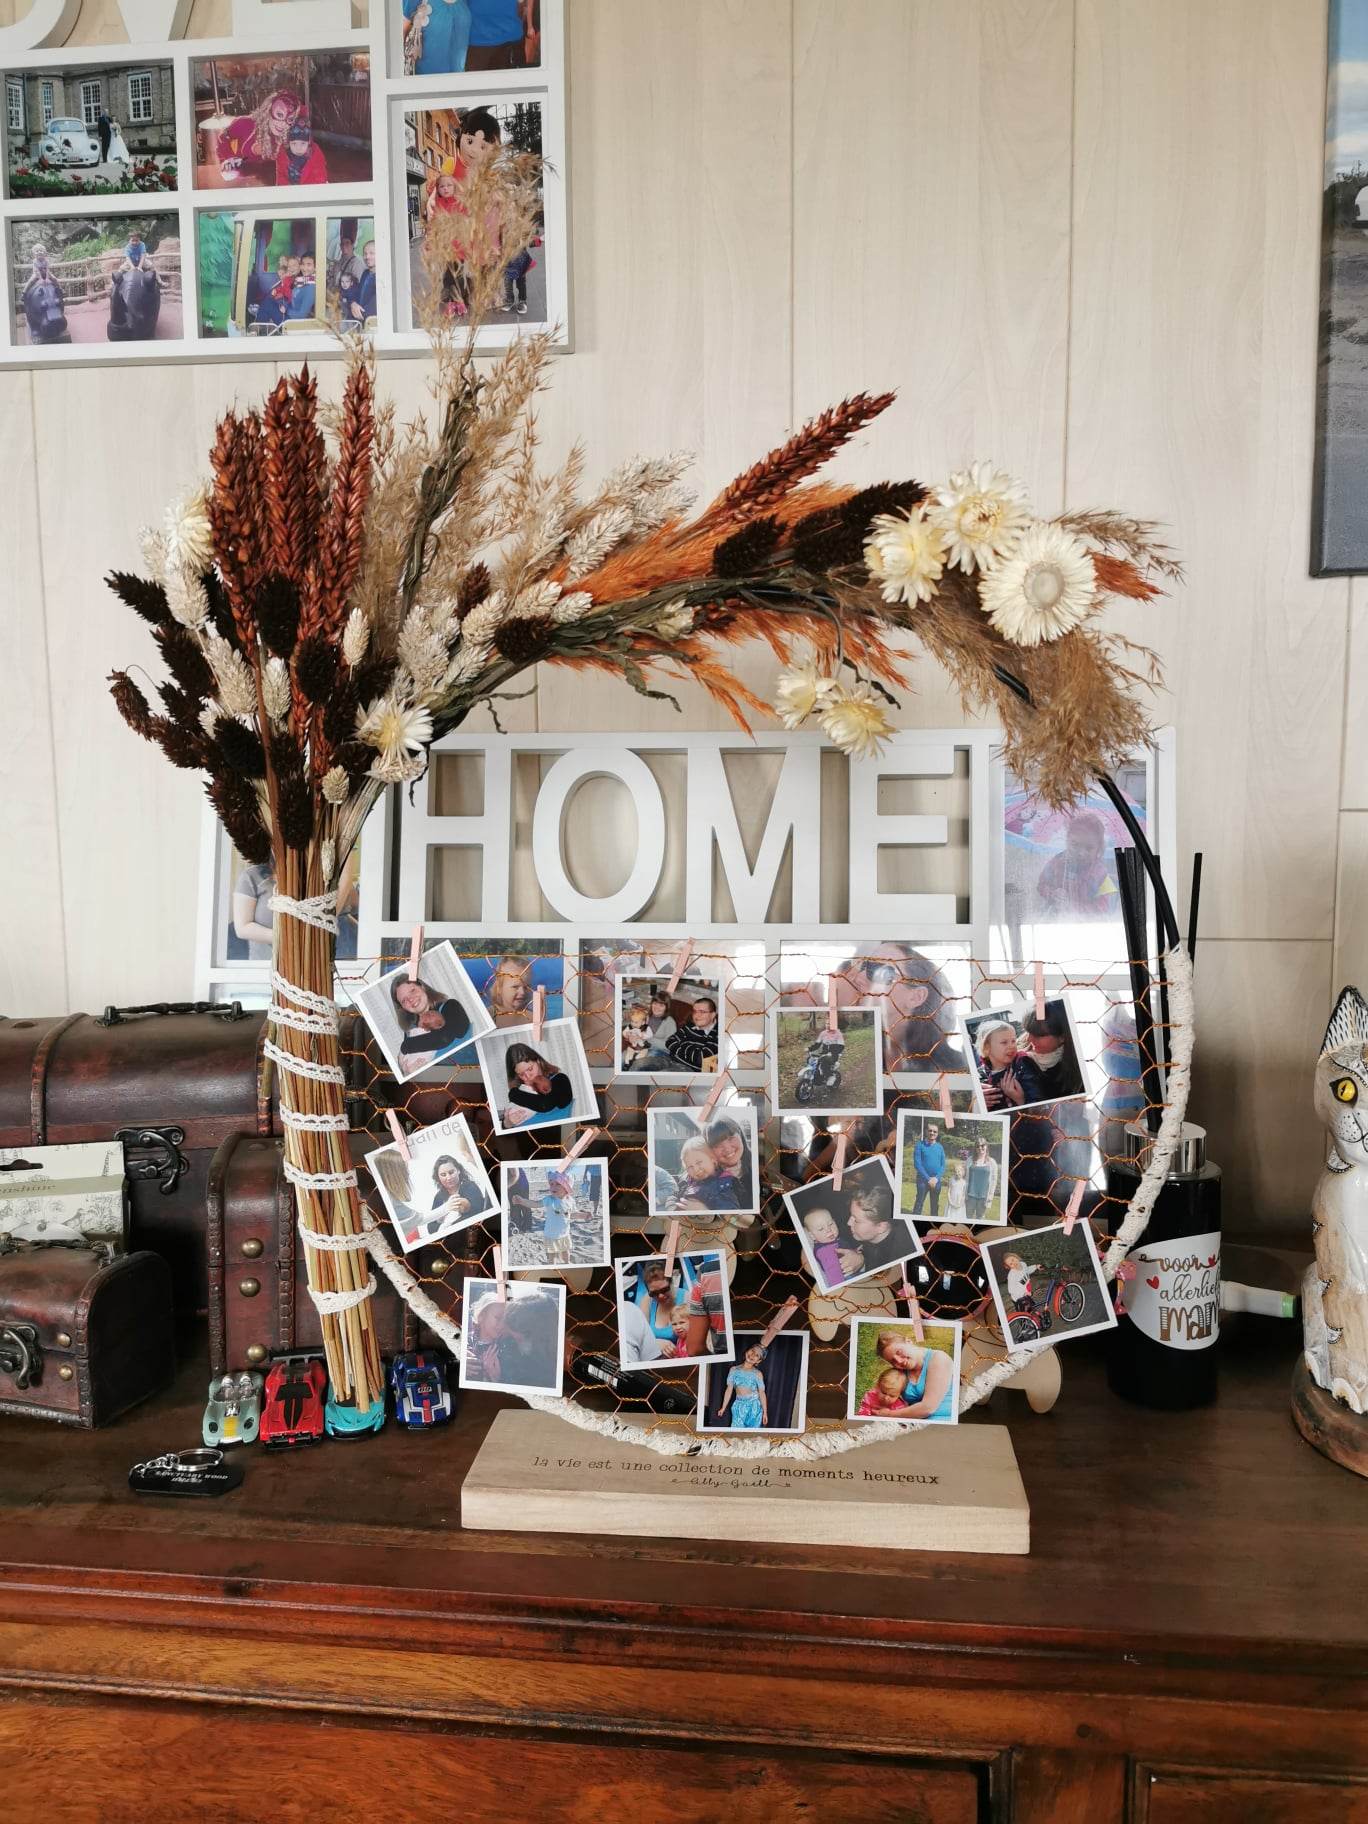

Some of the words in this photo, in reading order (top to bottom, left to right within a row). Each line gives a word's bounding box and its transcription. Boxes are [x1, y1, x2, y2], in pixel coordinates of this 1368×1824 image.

[398, 746, 958, 924] HOME
[1155, 1253, 1207, 1273] voor
[532, 1456, 549, 1467] la
[557, 1458, 583, 1469] vie
[588, 1458, 613, 1470] est
[620, 1461, 653, 1472] une
[659, 1461, 744, 1477] collection
[752, 1465, 772, 1477] de
[779, 1467, 855, 1481] moments
[863, 1469, 940, 1485] heureux
